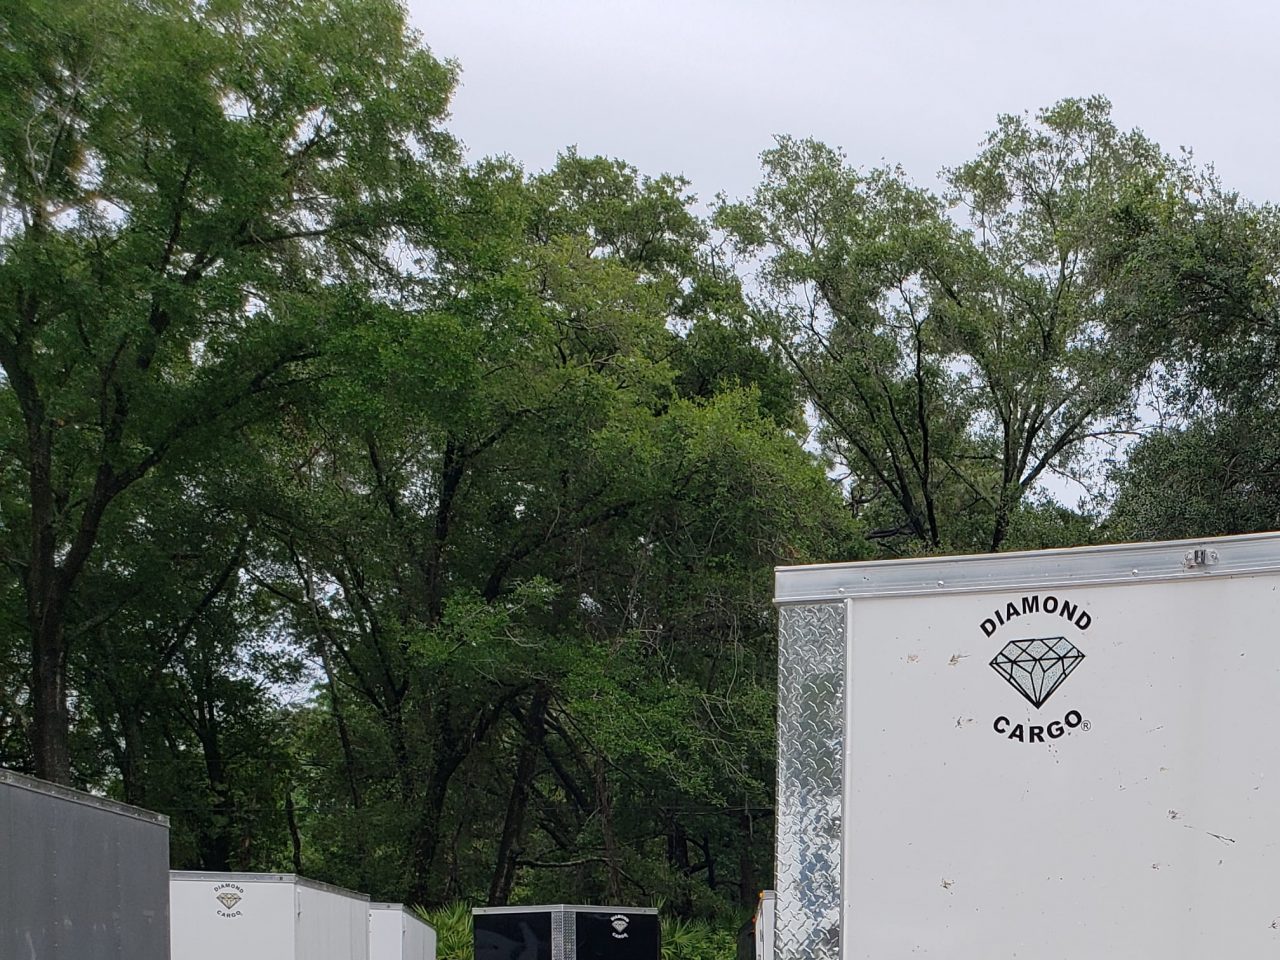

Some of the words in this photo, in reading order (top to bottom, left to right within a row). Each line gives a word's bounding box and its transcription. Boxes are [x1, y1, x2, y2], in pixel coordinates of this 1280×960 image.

[980, 595, 1092, 638] DIAMOND
[993, 709, 1082, 743] CARGO
[213, 883, 244, 894] DIAMOND
[216, 909, 241, 918] CARGO
